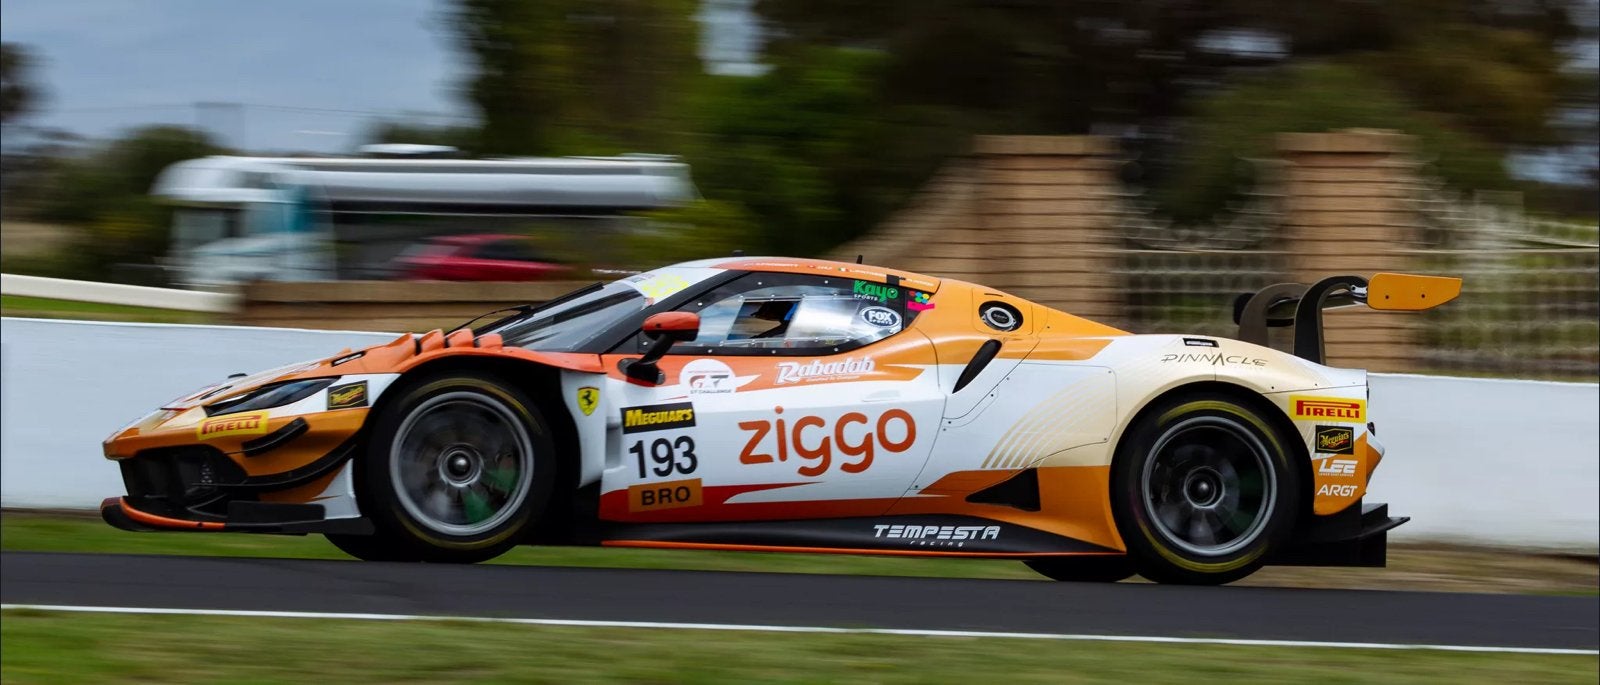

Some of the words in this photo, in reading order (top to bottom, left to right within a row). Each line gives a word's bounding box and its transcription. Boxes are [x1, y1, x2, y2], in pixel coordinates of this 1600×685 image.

[853, 280, 898, 303] Kayo
[854, 293, 878, 301] SPORTS
[868, 310, 893, 322] FOX
[1161, 352, 1268, 367] PINNACLE
[1296, 400, 1360, 419] PIRELLI
[202, 415, 261, 434] PIRELLI
[738, 405, 917, 478] ziggo
[629, 434, 699, 479] 193
[1318, 458, 1358, 474] LEE
[641, 485, 691, 507] BRO
[1317, 484, 1358, 497] ARGT
[873, 524, 1001, 540] TEMPESTA
